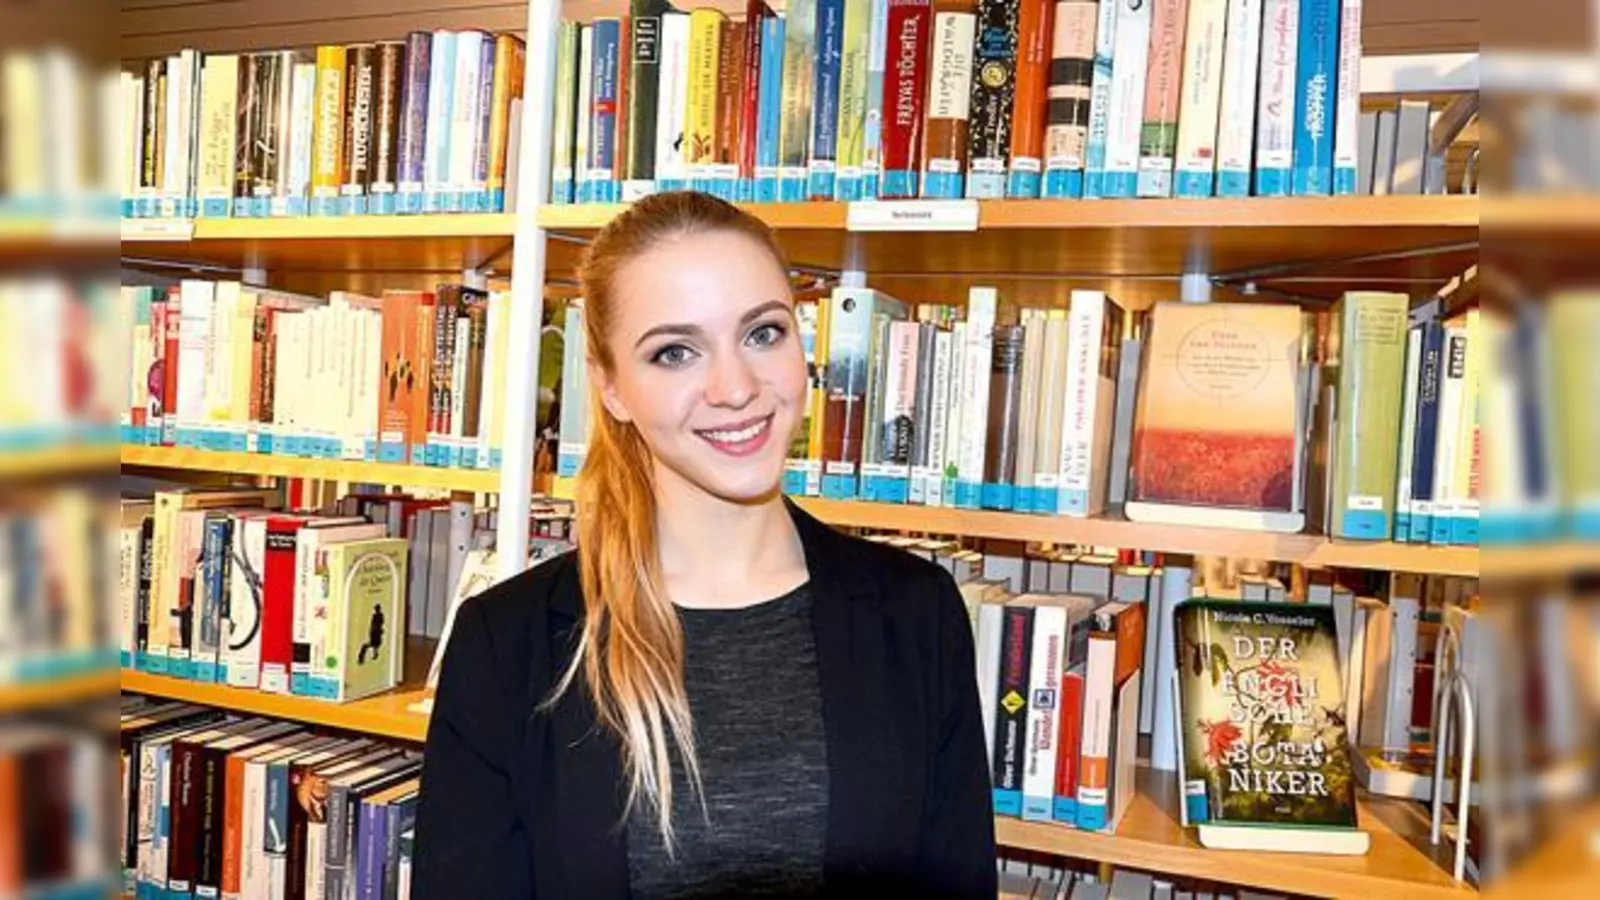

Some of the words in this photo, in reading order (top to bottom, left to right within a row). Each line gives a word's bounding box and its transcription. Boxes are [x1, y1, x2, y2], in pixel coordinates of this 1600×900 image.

[896, 16, 920, 78] TÖCHTER
[897, 81, 915, 126] FREYAS
[1214, 610, 1252, 623] Nicole
[1233, 635, 1298, 661] DER
[1222, 671, 1318, 698] ENGLI
[1228, 768, 1329, 797] NIKER
